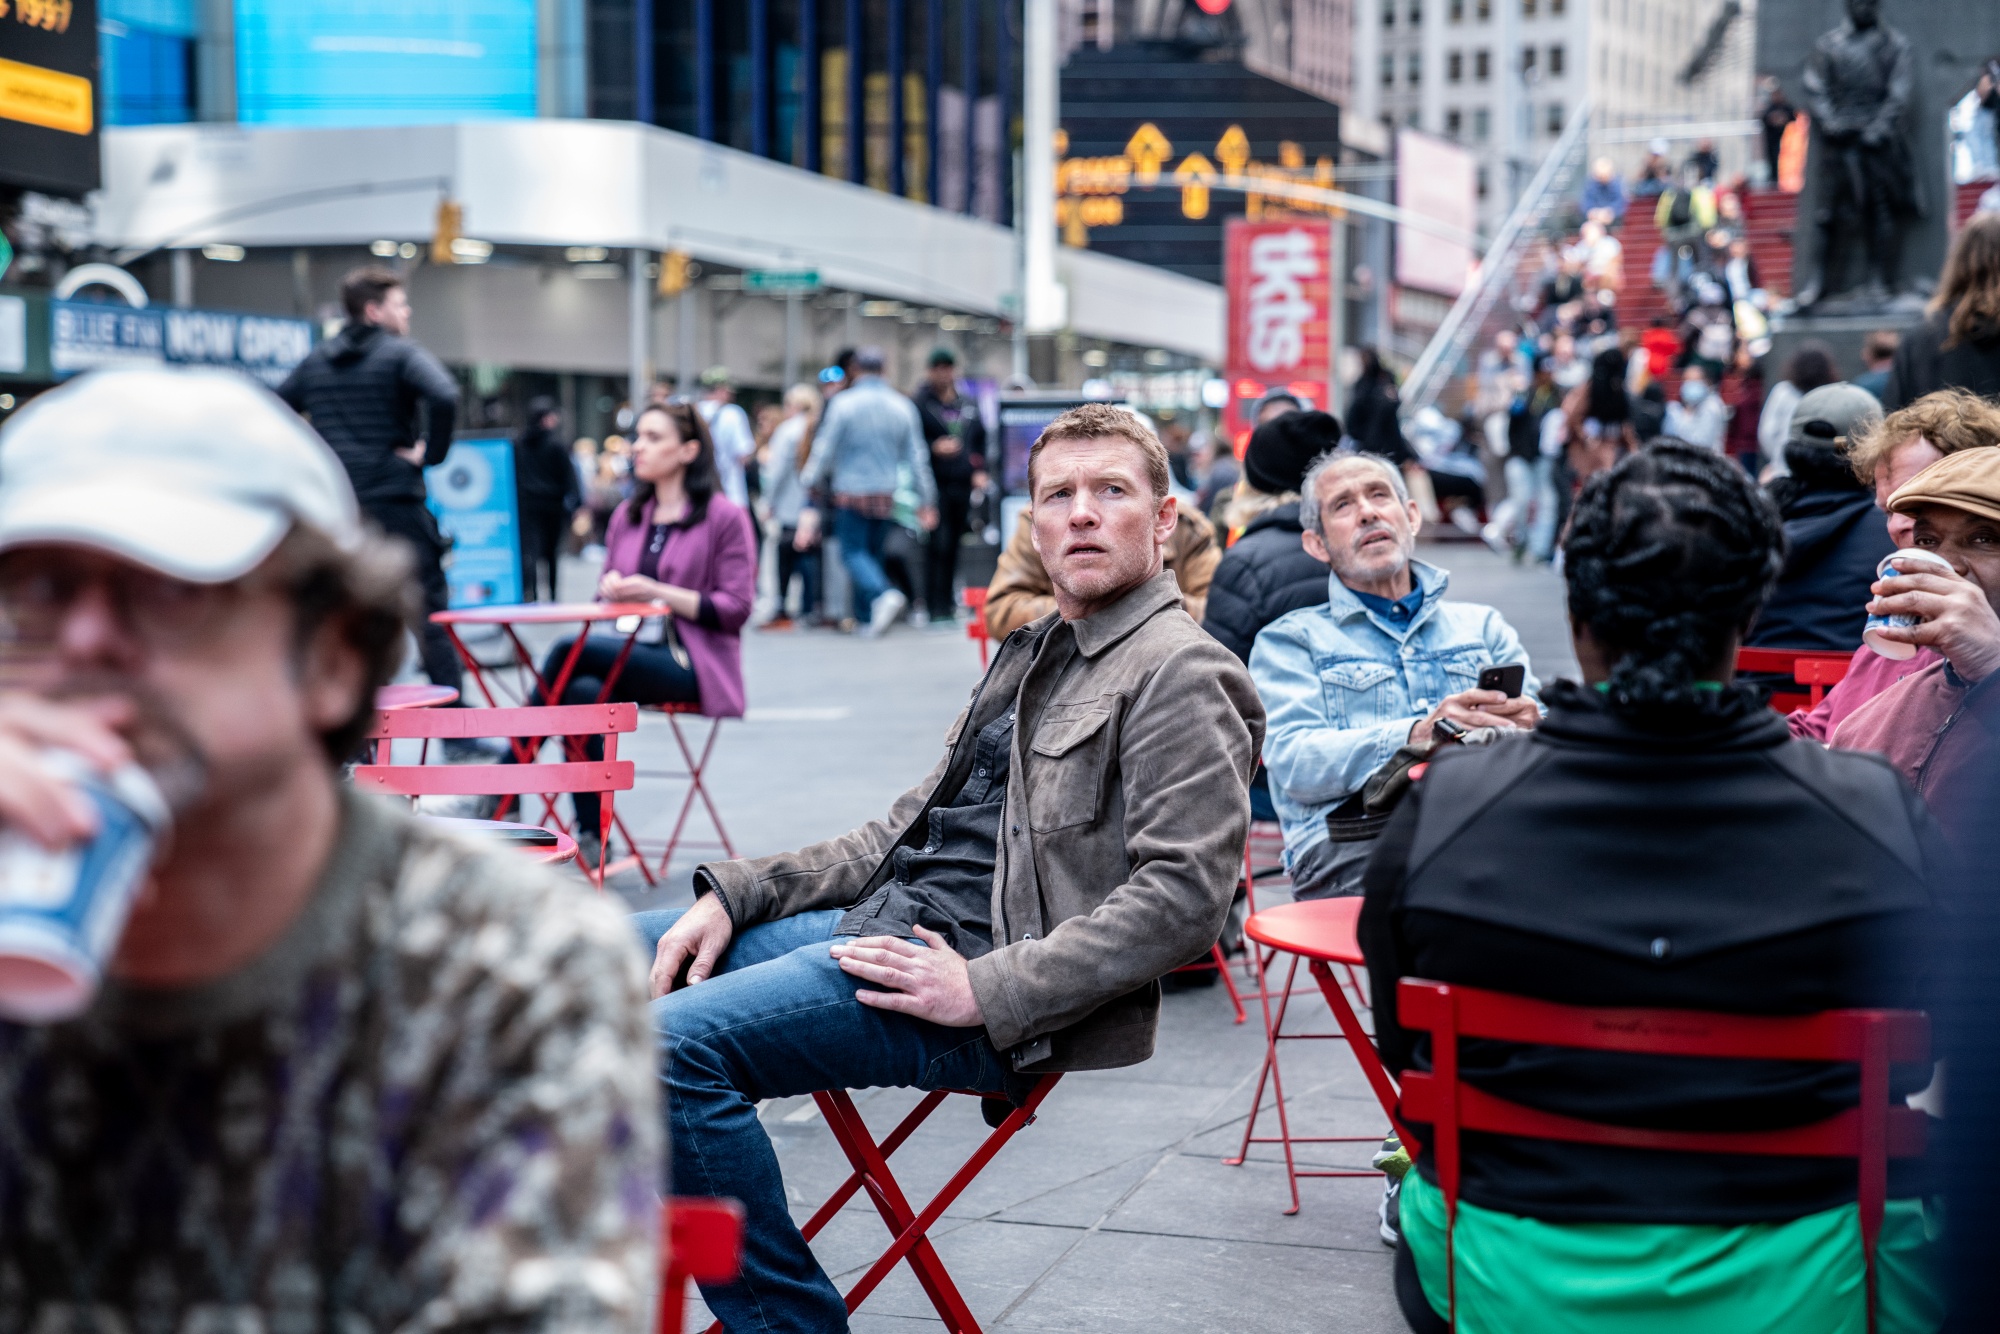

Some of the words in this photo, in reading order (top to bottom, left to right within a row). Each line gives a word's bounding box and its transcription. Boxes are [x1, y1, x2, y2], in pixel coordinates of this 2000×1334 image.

[166, 310, 237, 362] NOW
[239, 315, 312, 368] OPEN
[1249, 229, 1318, 371] tkts
